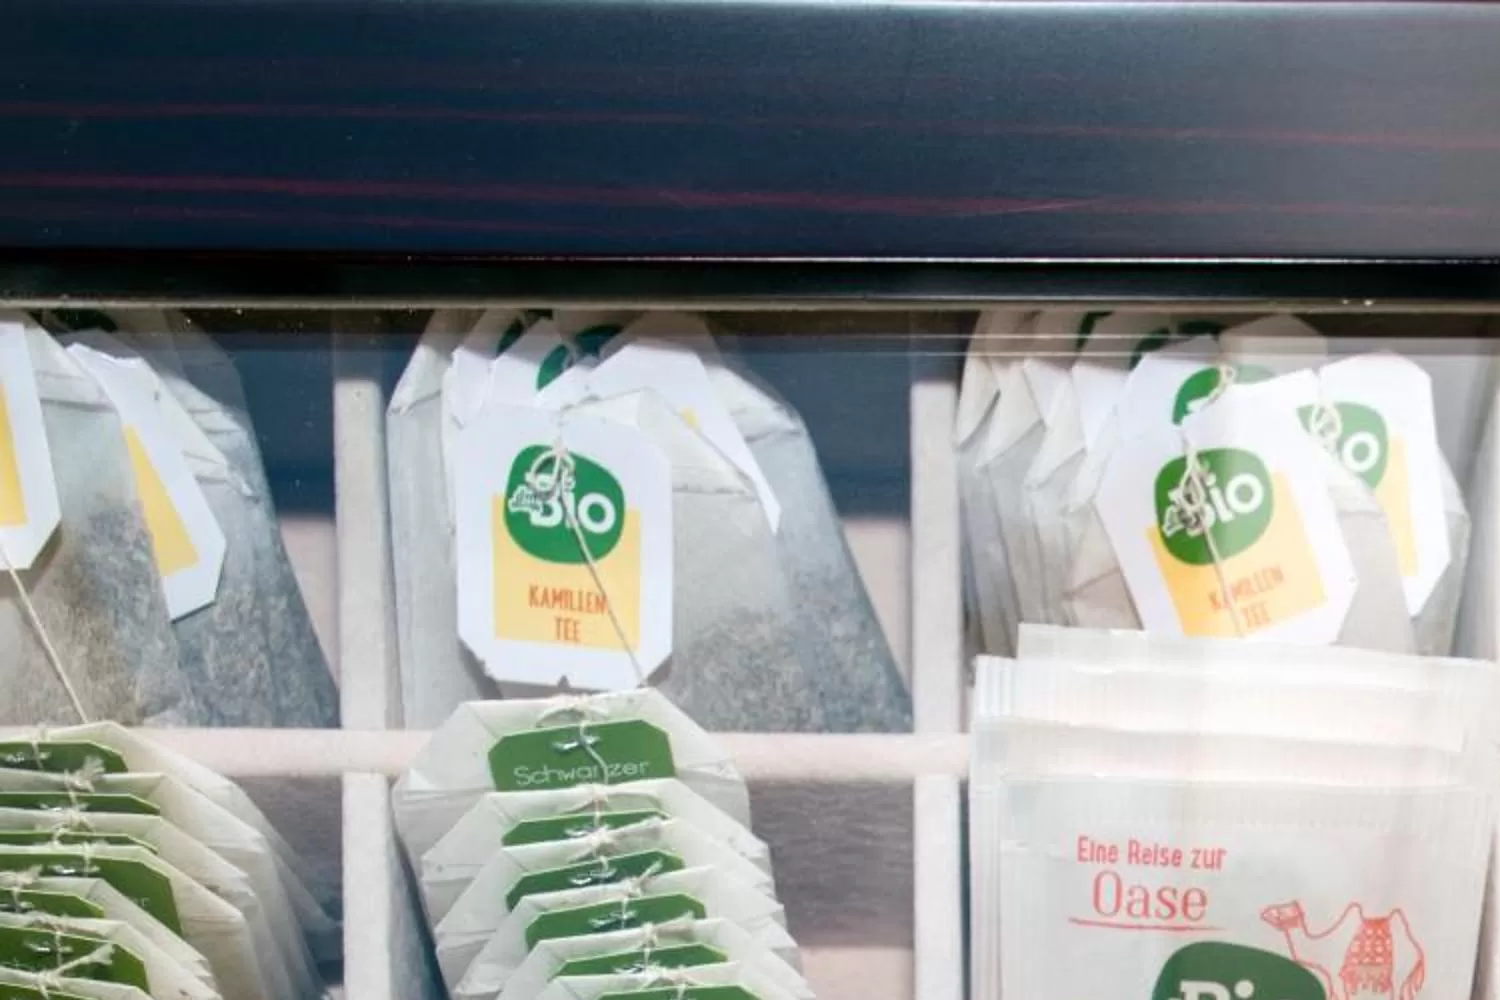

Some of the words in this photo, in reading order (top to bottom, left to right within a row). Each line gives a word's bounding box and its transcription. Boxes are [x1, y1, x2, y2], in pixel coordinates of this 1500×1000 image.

[528, 584, 608, 614] KAMILLEN
[555, 617, 581, 642] TEE
[1077, 835, 1119, 865] Eine
[1128, 840, 1183, 868] Reise
[1190, 847, 1227, 870] zur
[1092, 869, 1209, 921] Oase
